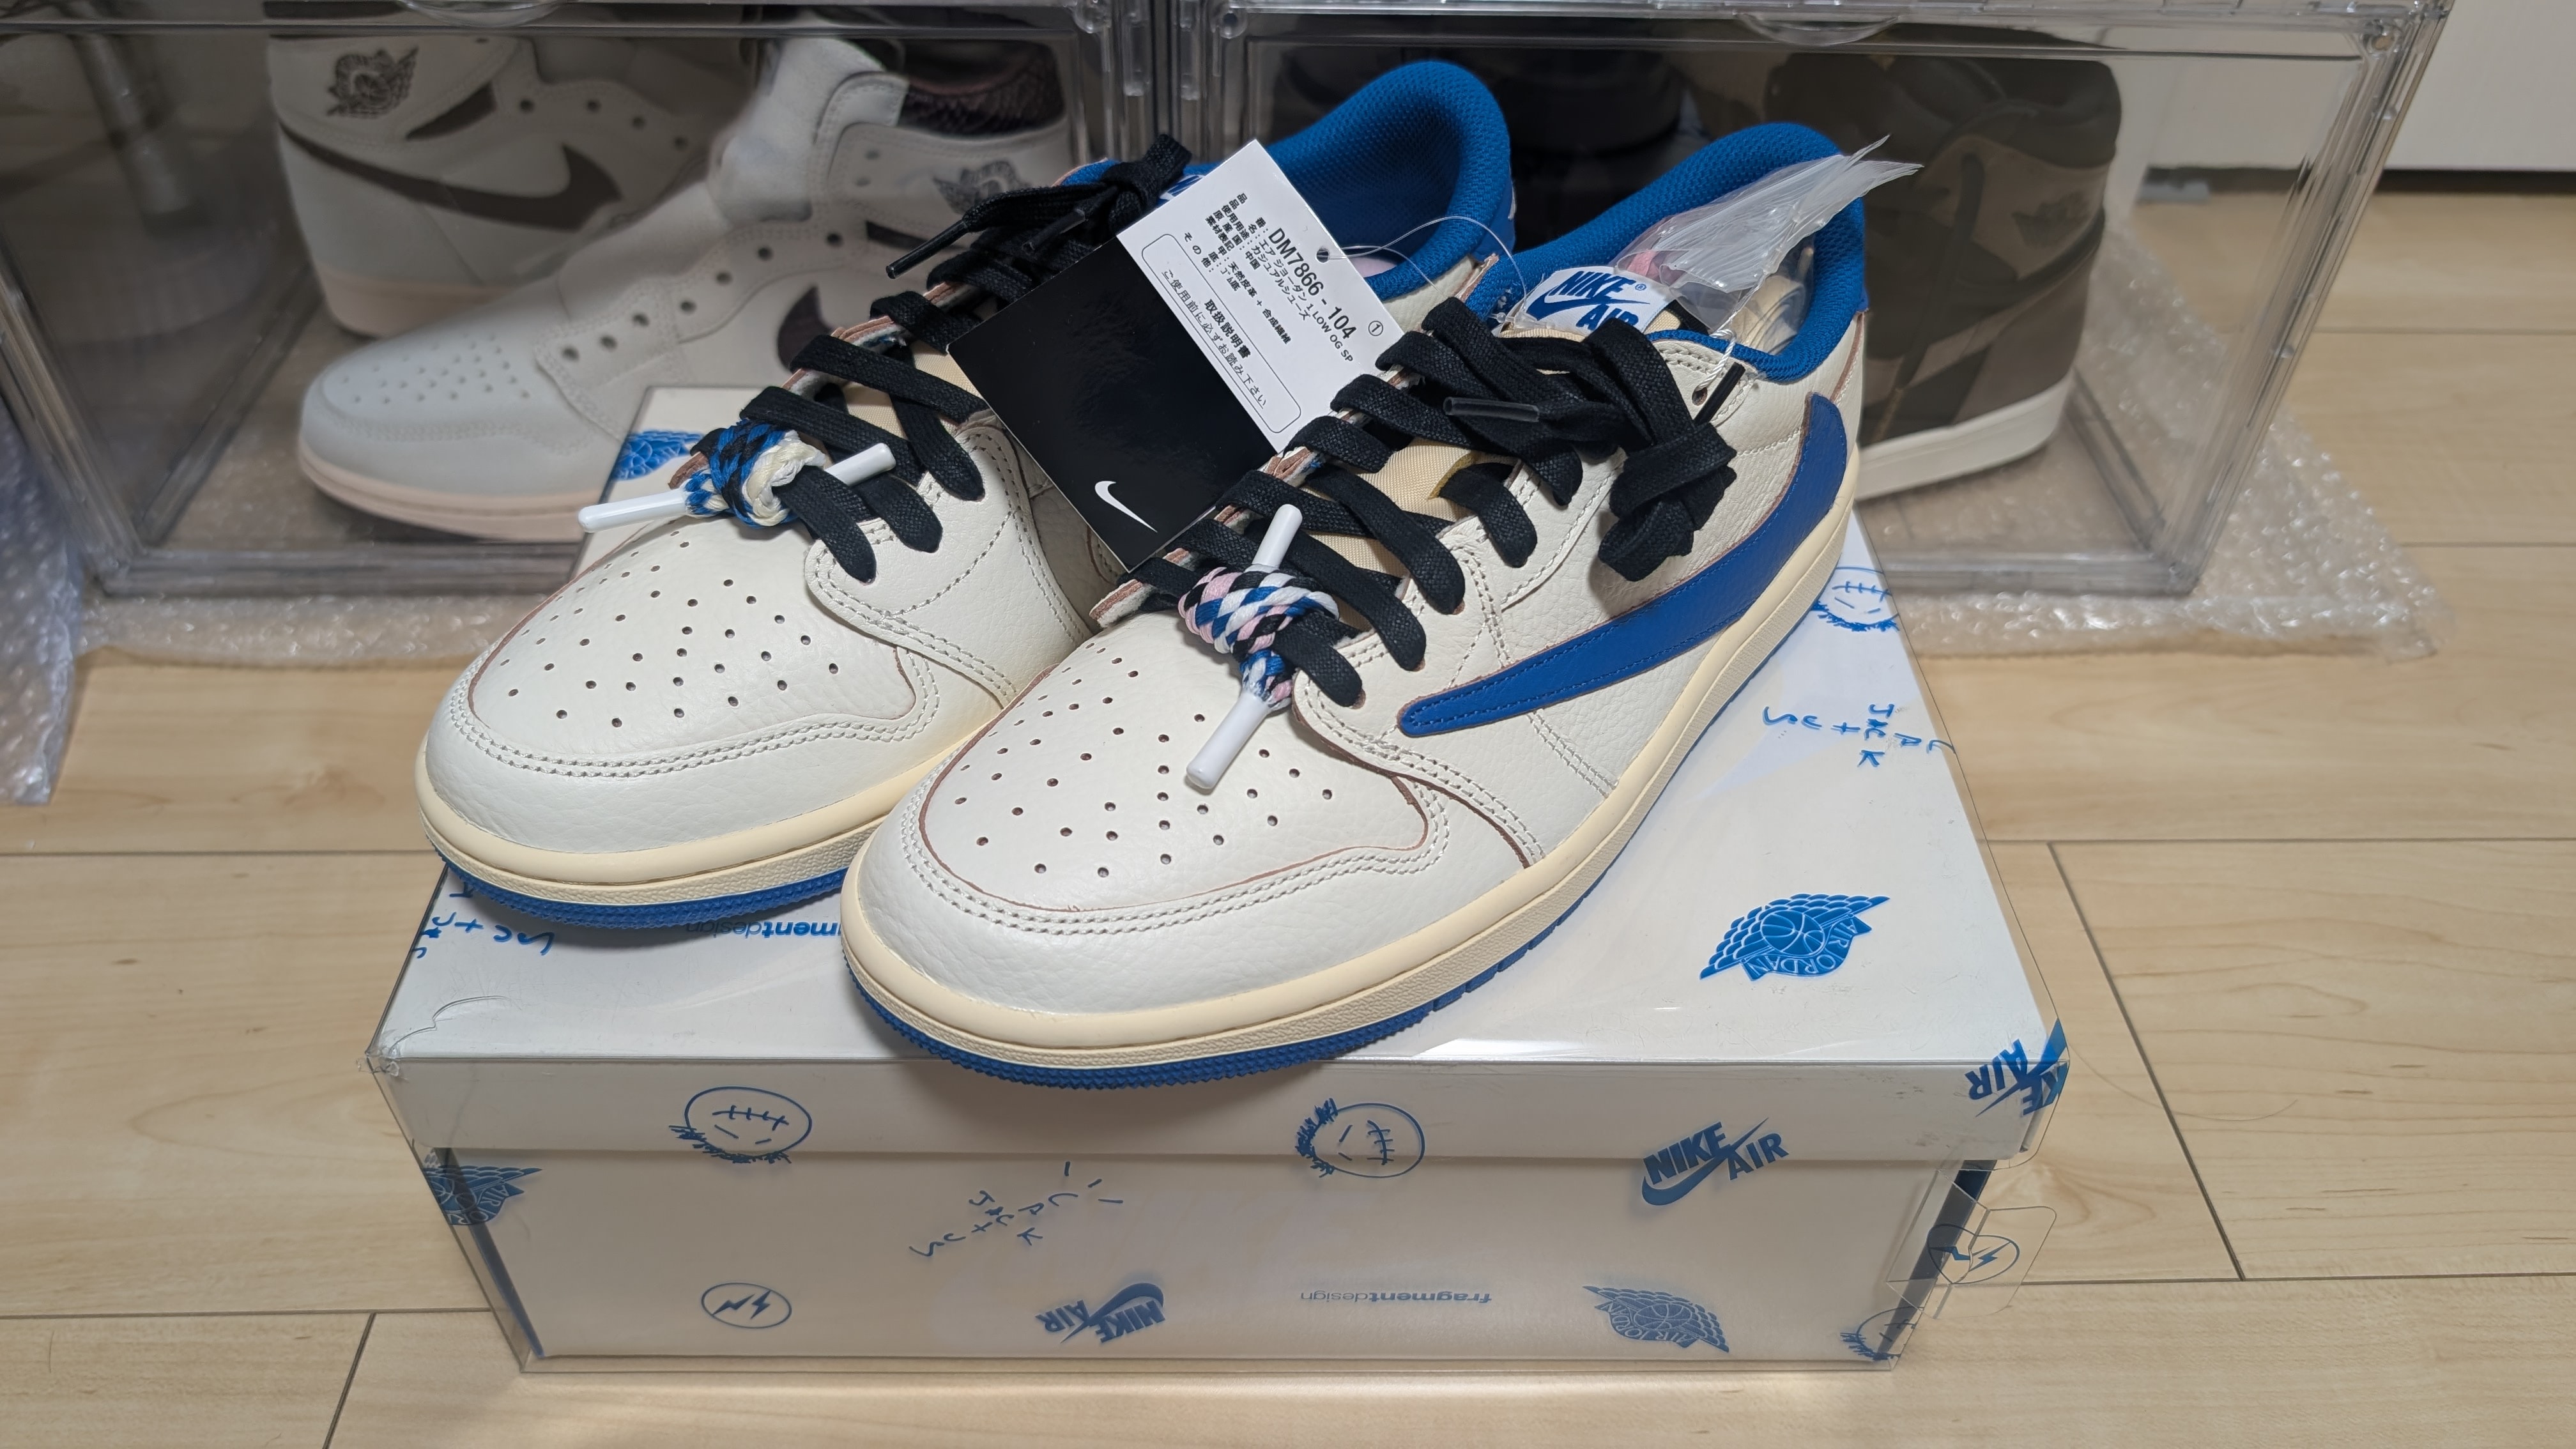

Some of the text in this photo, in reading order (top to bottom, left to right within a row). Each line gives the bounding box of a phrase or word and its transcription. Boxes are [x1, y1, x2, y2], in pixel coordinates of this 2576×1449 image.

[1205, 215, 1235, 252] 素材表記
[1227, 261, 1258, 298] 天然皮革
[1245, 250, 1261, 270] 中国
[1268, 227, 1324, 296] DM7866
[1328, 306, 1357, 340] 104
[1547, 270, 1637, 299] NIKE
[1161, 270, 1266, 410] ご使用前に必ずお読み下さい
[1204, 298, 1251, 359] 取扱説明書
[1312, 310, 1332, 333] LOW
[1330, 334, 1343, 349] OG
[1340, 349, 1353, 362] SP
[685, 921, 841, 939] mentdesign
[1746, 920, 1859, 976] AIR JORDAN
[1964, 1038, 2028, 1100] AIR
[1643, 1121, 1731, 1186] NIKE
[1727, 1133, 1790, 1181] AIR
[1034, 1299, 1091, 1333] AIR
[1300, 1290, 1492, 1304] fragmentdesign
[1094, 1300, 1166, 1344] NIKE
